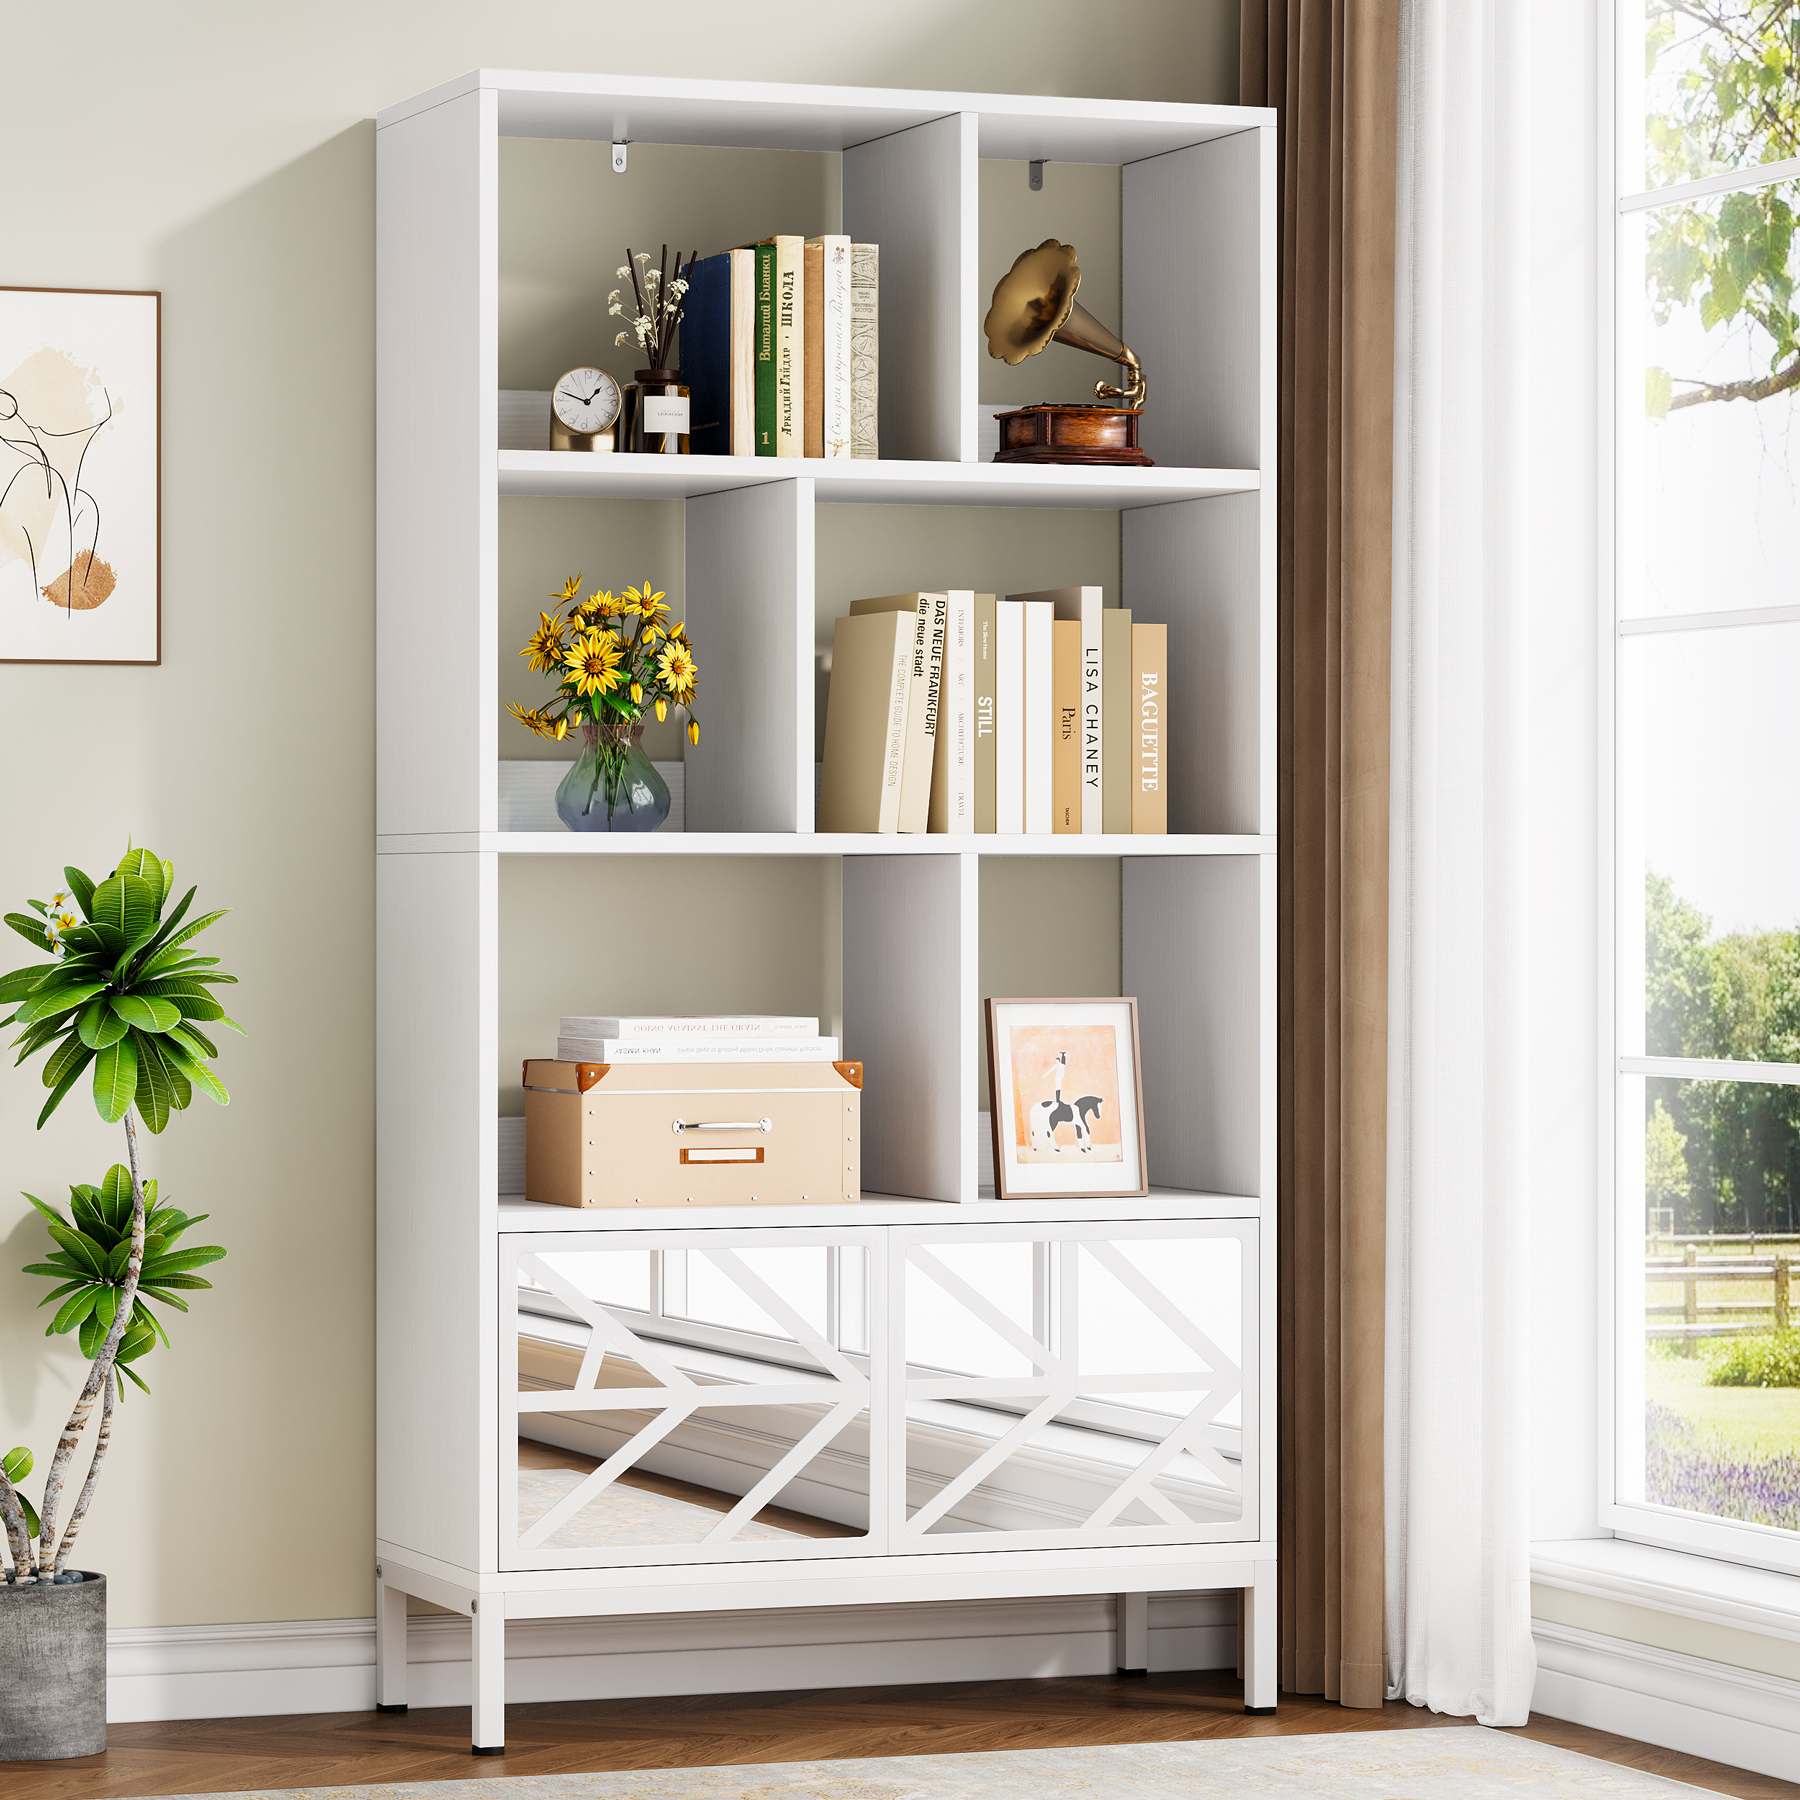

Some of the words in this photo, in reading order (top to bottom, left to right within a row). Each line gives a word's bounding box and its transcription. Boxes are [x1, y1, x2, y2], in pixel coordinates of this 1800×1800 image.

[759, 254, 771, 302] Бианки
[781, 270, 795, 327] ШКОЛА
[759, 305, 771, 361] Виталий
[761, 431, 770, 445] 1
[919, 598, 930, 615] die
[934, 600, 946, 625] DAS
[916, 618, 926, 646] neue
[930, 629, 944, 662] NEUE
[898, 654, 908, 667] THE
[913, 649, 925, 678] stadt
[1085, 648, 1099, 693] LISA
[894, 669, 906, 704] COMPLETE
[924, 665, 940, 737] FRANKFURT
[892, 706, 903, 727] GUIDE
[978, 696, 993, 738] STILL
[1062, 707, 1076, 740] Paris
[1141, 672, 1159, 792] BAGUETTE
[890, 739, 900, 759] HOME
[891, 729, 901, 738] TO
[1085, 704, 1099, 788] CHANEY
[887, 761, 898, 788] DESIGN
